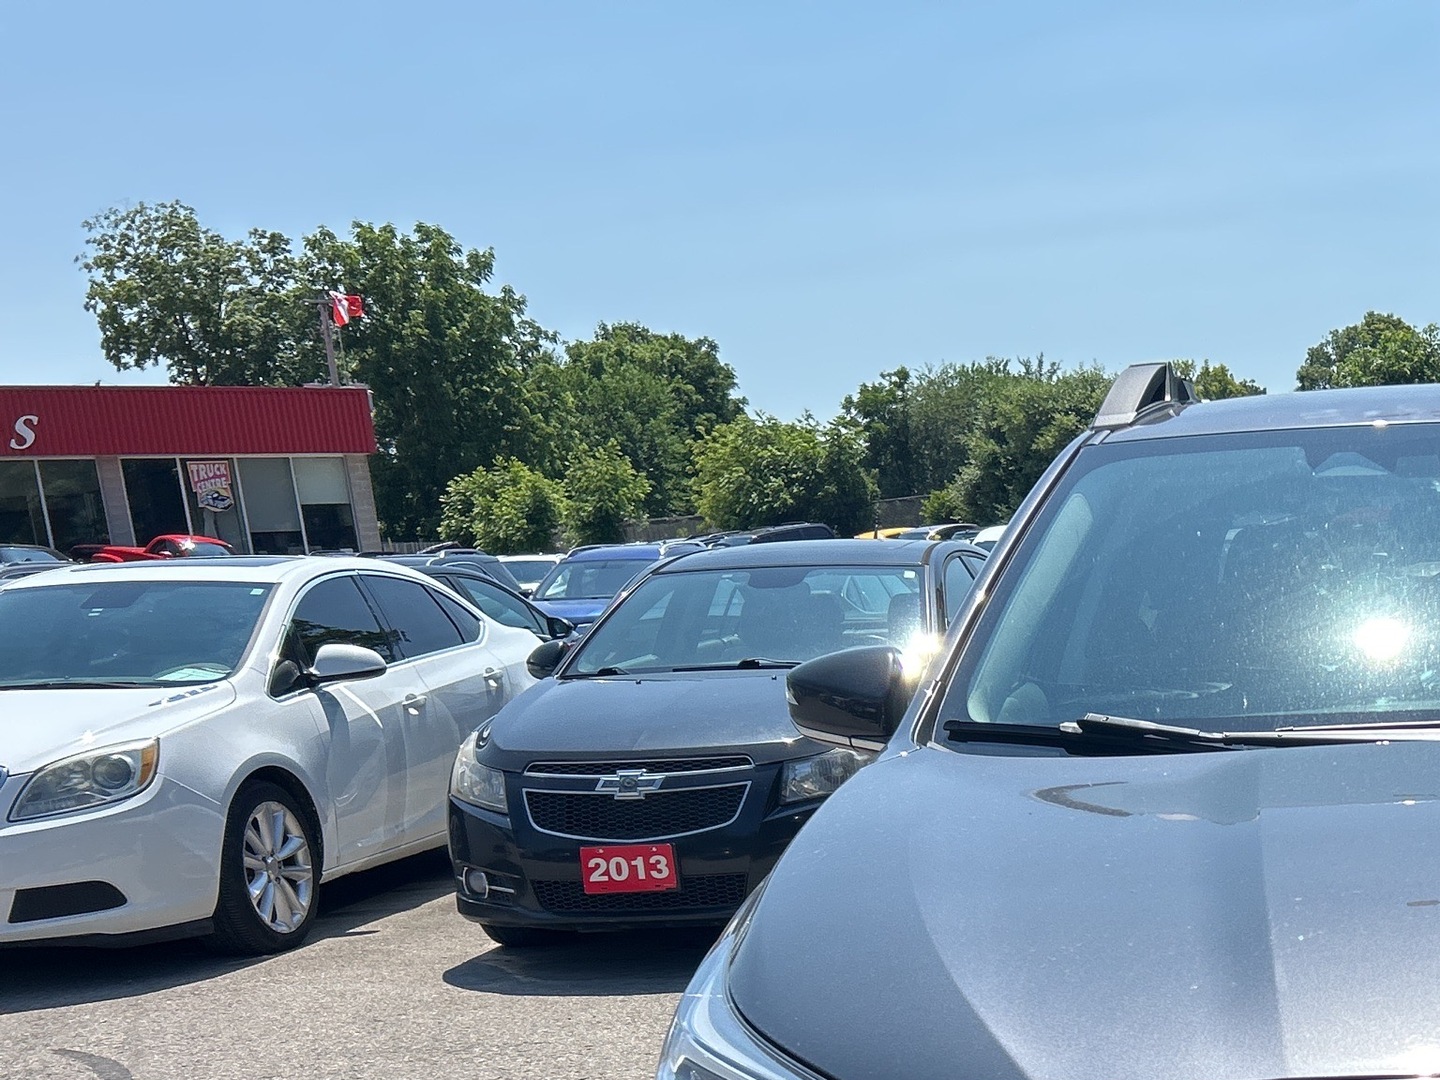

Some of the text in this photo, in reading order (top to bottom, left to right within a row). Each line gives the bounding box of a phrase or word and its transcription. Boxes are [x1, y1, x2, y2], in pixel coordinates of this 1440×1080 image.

[190, 463, 227, 482] TRUCK
[197, 477, 228, 494] CENTRE
[588, 854, 670, 883] 2013
